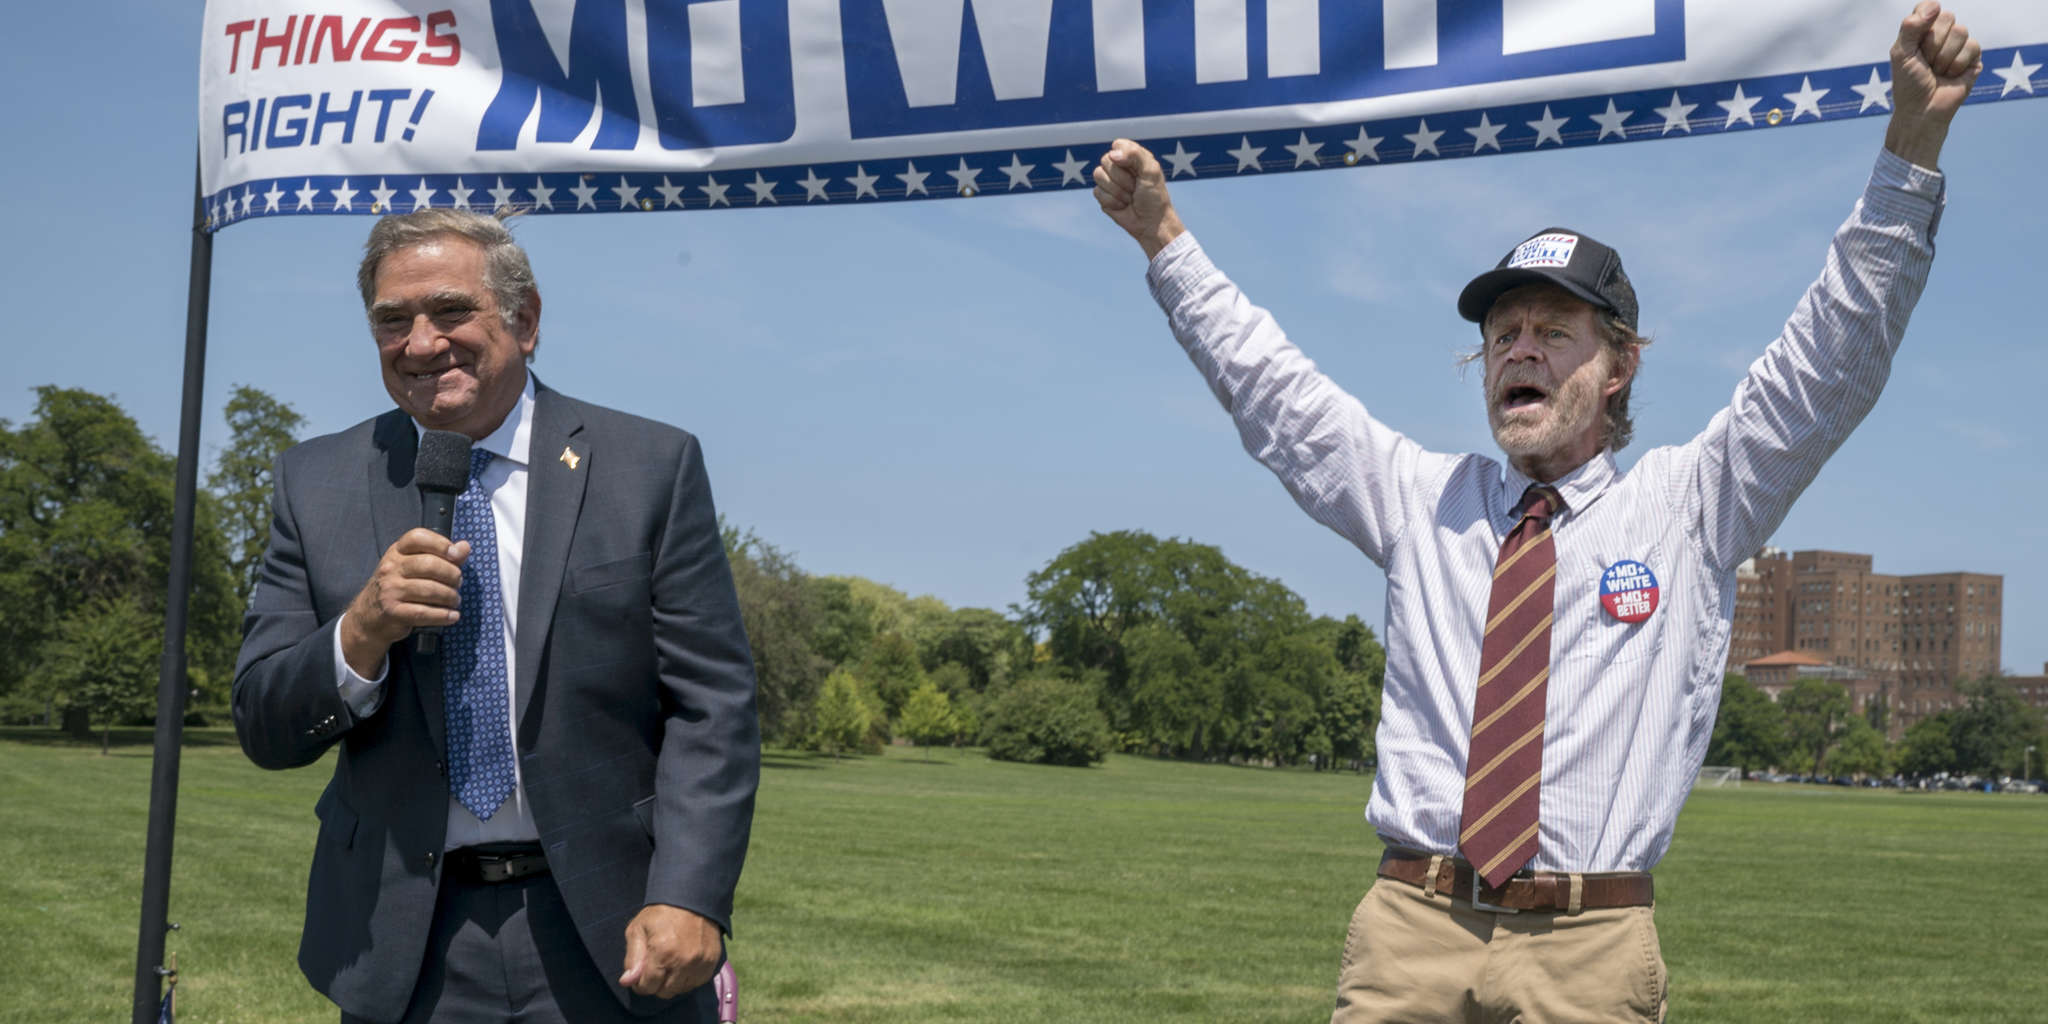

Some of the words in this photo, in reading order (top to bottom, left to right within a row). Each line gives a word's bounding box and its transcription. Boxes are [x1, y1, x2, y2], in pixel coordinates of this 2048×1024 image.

[225, 9, 462, 74] THINGS
[223, 88, 435, 159] RIGHT!
[1615, 563, 1637, 578] MO
[1606, 574, 1652, 593] WHITE
[1621, 590, 1642, 604] MO
[1616, 601, 1651, 617] BETTER
